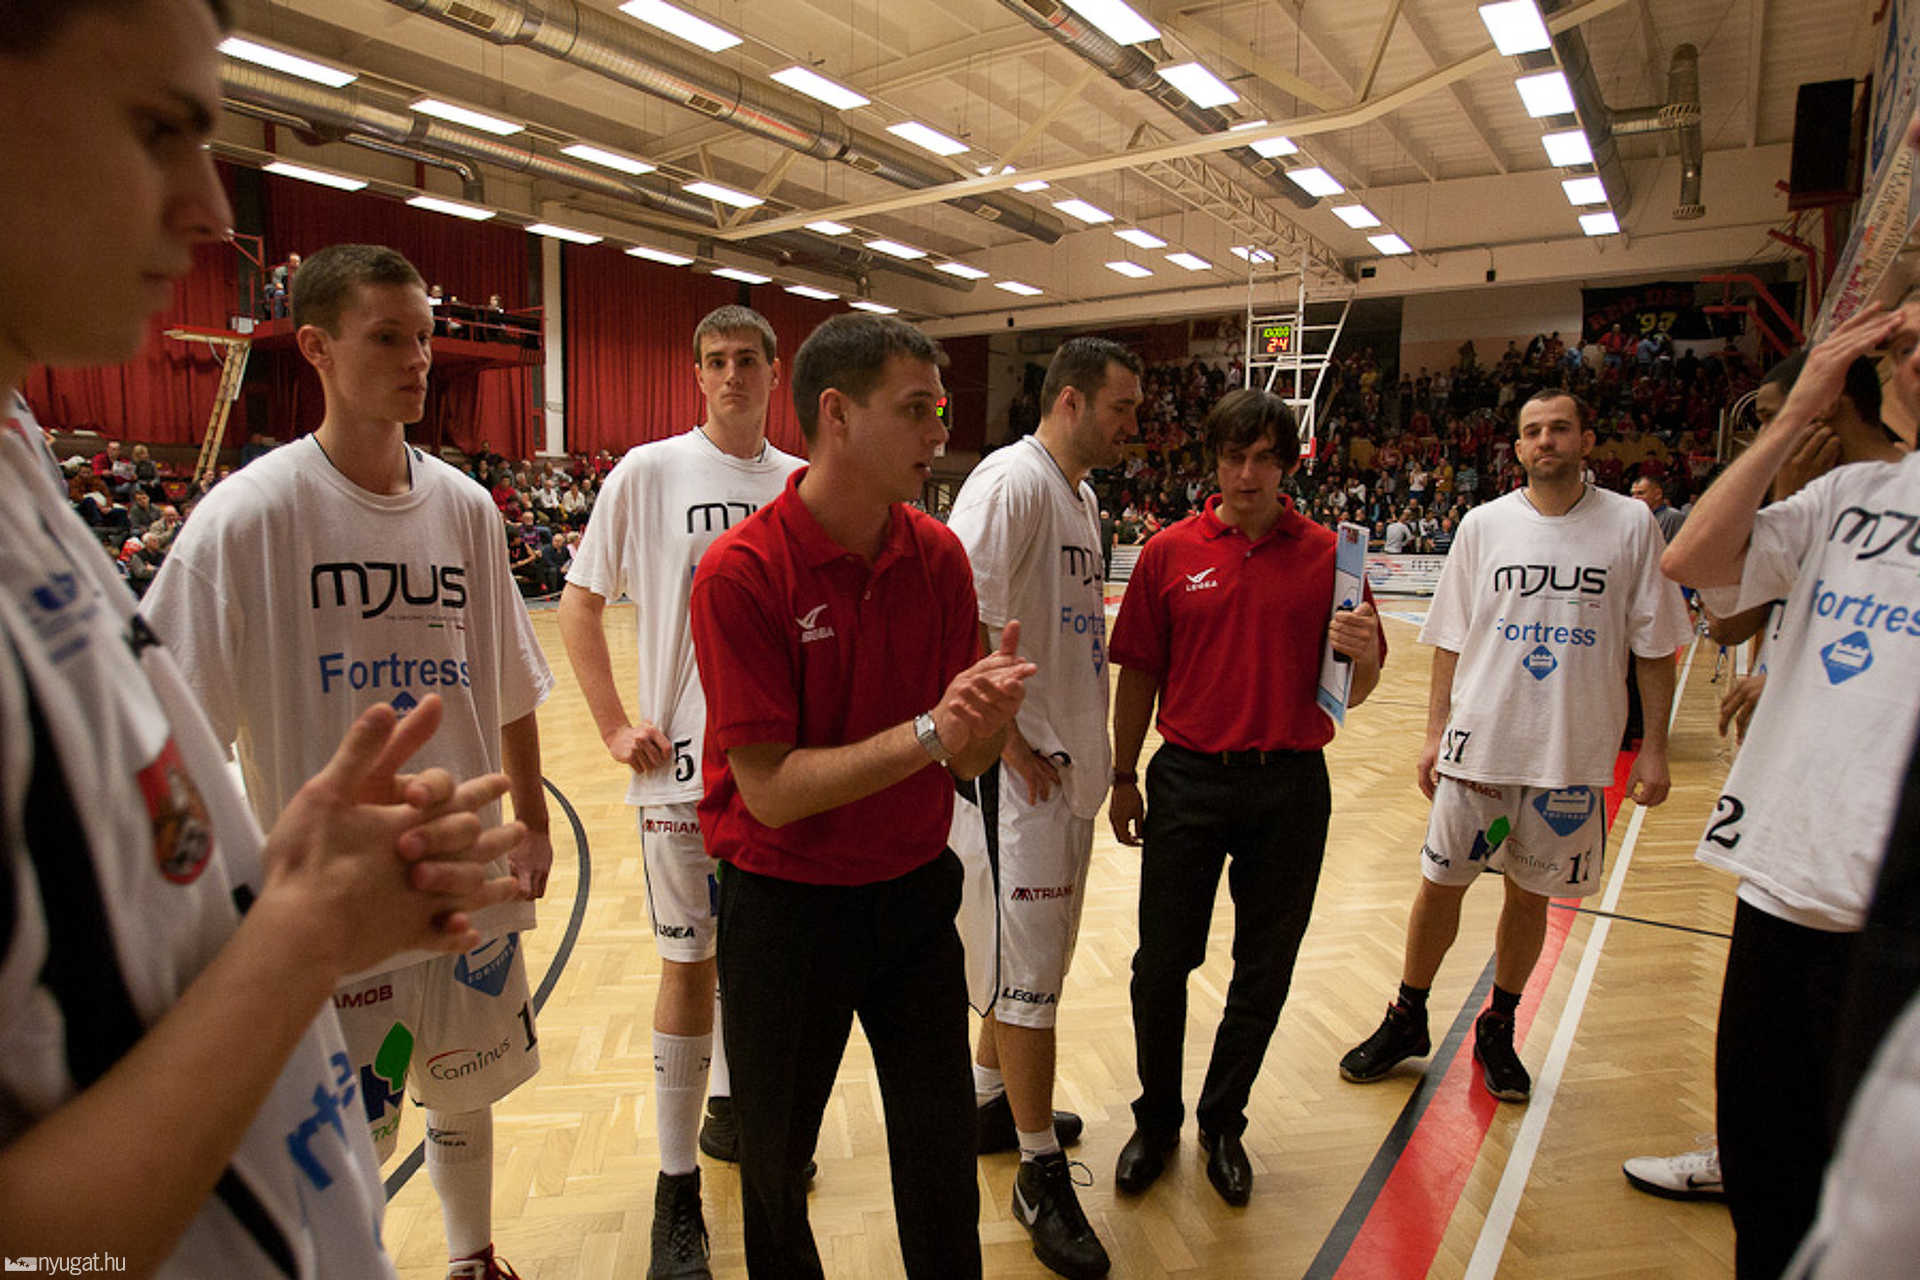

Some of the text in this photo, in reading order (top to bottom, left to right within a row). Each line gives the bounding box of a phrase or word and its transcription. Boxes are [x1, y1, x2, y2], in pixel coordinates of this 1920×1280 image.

[1266, 338, 1289, 352] 24
[318, 652, 472, 693] Fortress
[673, 738, 695, 782] 5
[1443, 729, 1472, 764] 17
[1706, 795, 1744, 850] 2
